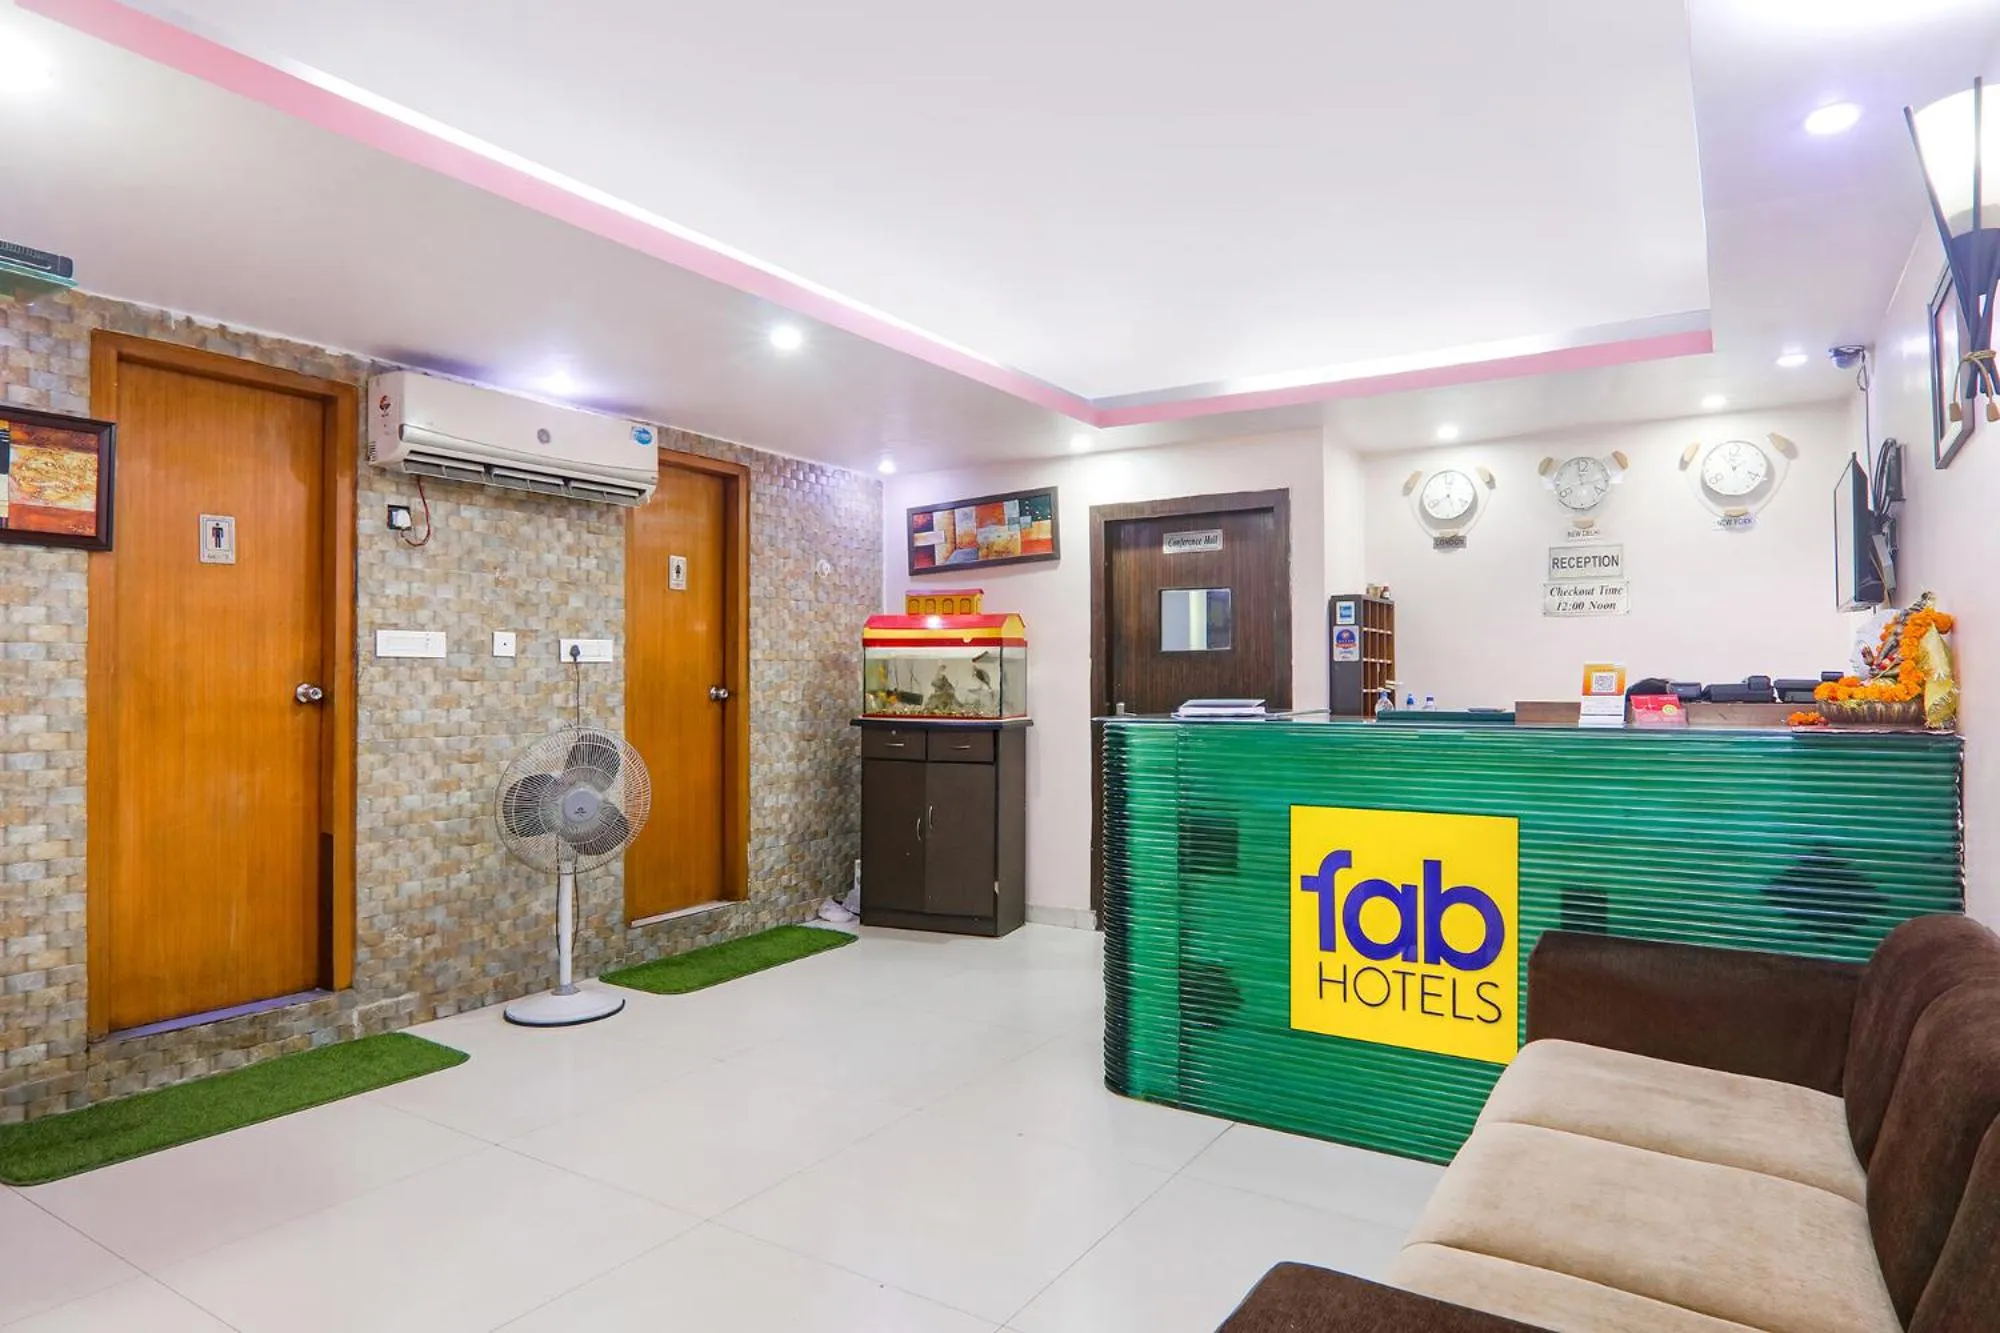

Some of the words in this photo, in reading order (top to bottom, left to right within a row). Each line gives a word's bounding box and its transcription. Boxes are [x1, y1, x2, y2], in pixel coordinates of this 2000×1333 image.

[1577, 459, 1589, 473] 12
[1708, 472, 1724, 485] 8
[1559, 486, 1573, 499] 8
[1167, 535, 1202, 548] Conference
[1203, 534, 1218, 545] Hall
[1551, 554, 1620, 570] RECEPTION
[1549, 585, 1596, 598] Checkout
[1599, 584, 1624, 596] Time
[1556, 601, 1585, 612] 12:00
[1588, 600, 1617, 611] Noon
[1300, 849, 1505, 972] fab
[1318, 960, 1502, 1025] HOTELS
